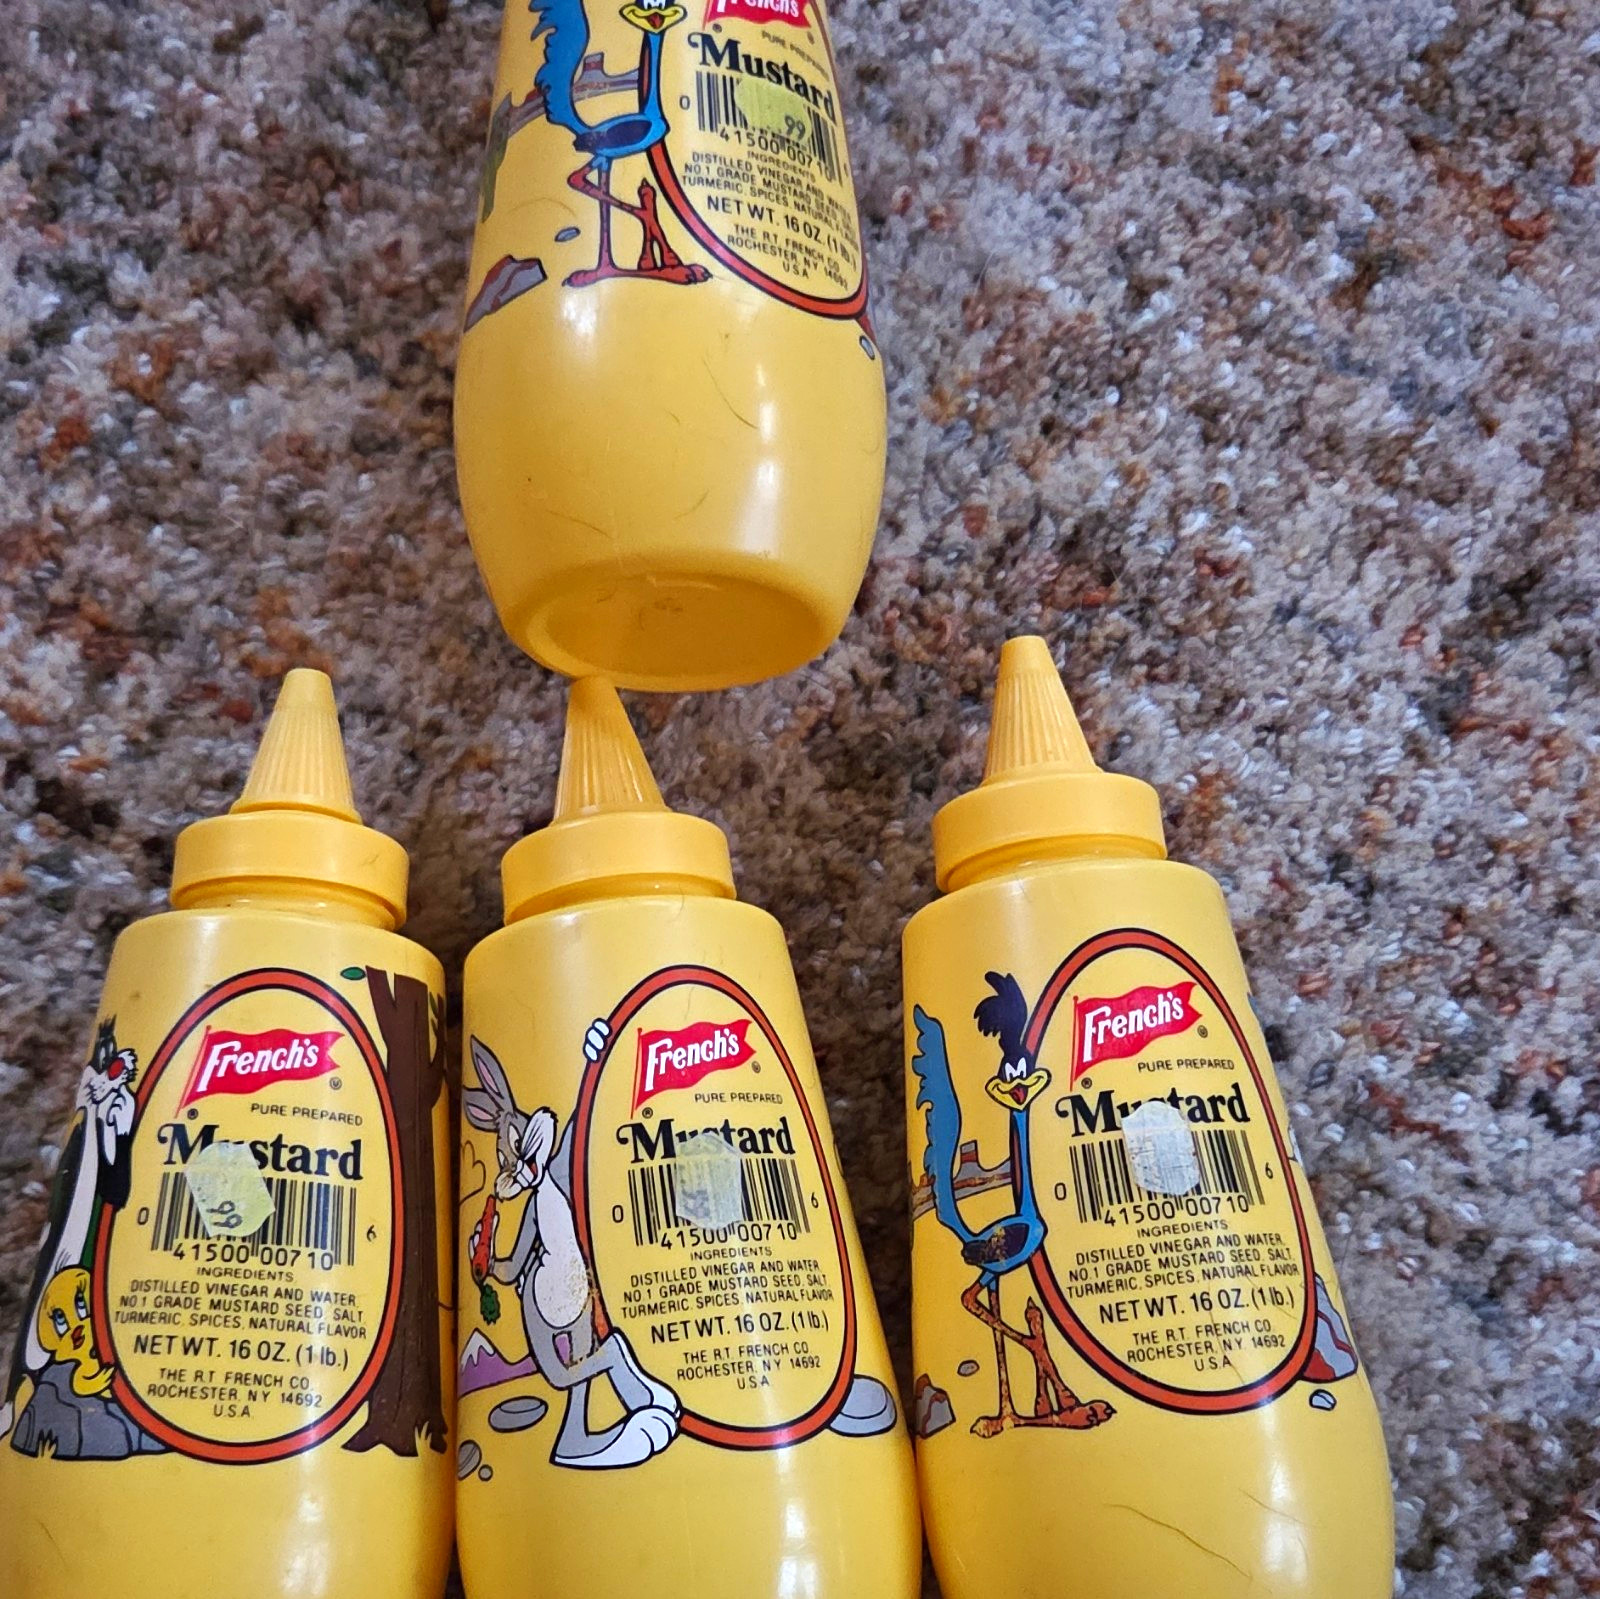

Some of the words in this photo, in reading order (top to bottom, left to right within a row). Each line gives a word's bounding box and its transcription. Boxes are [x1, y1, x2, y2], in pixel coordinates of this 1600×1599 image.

[688, 32, 837, 125] Mustard
[679, 95, 691, 110] 0
[719, 128, 779, 155] 41500
[692, 151, 753, 172] DISTILLED
[716, 166, 757, 186] GRADE
[707, 194, 743, 216] NET
[747, 202, 780, 226] WT.
[784, 213, 800, 233] 16
[734, 223, 758, 240] THE
[1083, 990, 1184, 1063] French's
[197, 1038, 320, 1093] French's
[645, 1028, 739, 1092] French's
[1137, 1059, 1173, 1073] PURE
[1177, 1059, 1235, 1071] PREPARED
[695, 1093, 725, 1104] PURE
[730, 1092, 783, 1105] PREPARED
[1055, 1082, 1250, 1137] Mtard
[251, 1103, 287, 1117] PURE
[293, 1106, 363, 1127] PREPARED
[157, 1122, 364, 1181] Mstard
[616, 1116, 796, 1164] Mtard
[1054, 1182, 1067, 1201] 0
[1103, 1200, 1176, 1227] 41500
[1185, 1194, 1250, 1217] 00710
[1265, 1162, 1274, 1180] 6
[612, 1204, 624, 1224] 0
[660, 1227, 728, 1250] 41500
[738, 1222, 797, 1242] 00710
[811, 1192, 819, 1209] 6
[1137, 1219, 1228, 1239] INGREDIENTS
[137, 1207, 150, 1226] 0
[173, 1242, 249, 1263] 41500
[260, 1247, 334, 1271] 00710
[367, 1224, 378, 1243] 6
[1076, 1243, 1145, 1266] DISTILLED
[1149, 1236, 1212, 1255] VINEGAR
[1216, 1234, 1241, 1248] AND
[690, 1246, 773, 1261] INGREDIENTS
[1106, 1258, 1152, 1277] GRADE
[1158, 1250, 1225, 1270] MUSTARD
[196, 1266, 294, 1282] INGREDIENTS
[630, 1266, 697, 1288] DISTILLED
[701, 1261, 755, 1277] VINEGAR
[760, 1260, 784, 1273] AND
[1201, 1263, 1259, 1281] NATURAL
[1260, 1263, 1300, 1277] FLAVOR
[130, 1279, 200, 1294] DISTILLED
[206, 1283, 269, 1298] VINEGAR
[274, 1286, 303, 1301] AND
[659, 1280, 703, 1299] GRADE
[709, 1276, 768, 1292] MUSTARD
[746, 1289, 799, 1304] NATURAL
[801, 1288, 834, 1301] FLAVOR
[154, 1295, 202, 1311] GRADE
[209, 1298, 279, 1315] MUSTARD
[1099, 1299, 1140, 1324] NET
[1144, 1294, 1185, 1318] WT.
[1190, 1291, 1213, 1312] 16
[1217, 1288, 1249, 1310] OZ.
[249, 1317, 314, 1335] NATURAL
[318, 1322, 367, 1339] FLAVOR
[651, 1320, 691, 1344] NET
[694, 1316, 731, 1338] WT.
[734, 1313, 755, 1333] 16
[759, 1312, 789, 1332] OZ.
[1132, 1329, 1160, 1346] THE
[1195, 1321, 1251, 1338] FRENCH
[134, 1334, 178, 1355] NET
[182, 1336, 221, 1357] WT.
[230, 1339, 251, 1359] 16
[257, 1341, 290, 1363] OZ.
[683, 1349, 708, 1364] THE
[738, 1343, 789, 1358] FRENCH
[1252, 1334, 1286, 1349] 14692
[789, 1355, 821, 1369] 14692
[160, 1367, 187, 1382] THE
[224, 1371, 283, 1387] FRENCH
[280, 1392, 322, 1408] 14692
